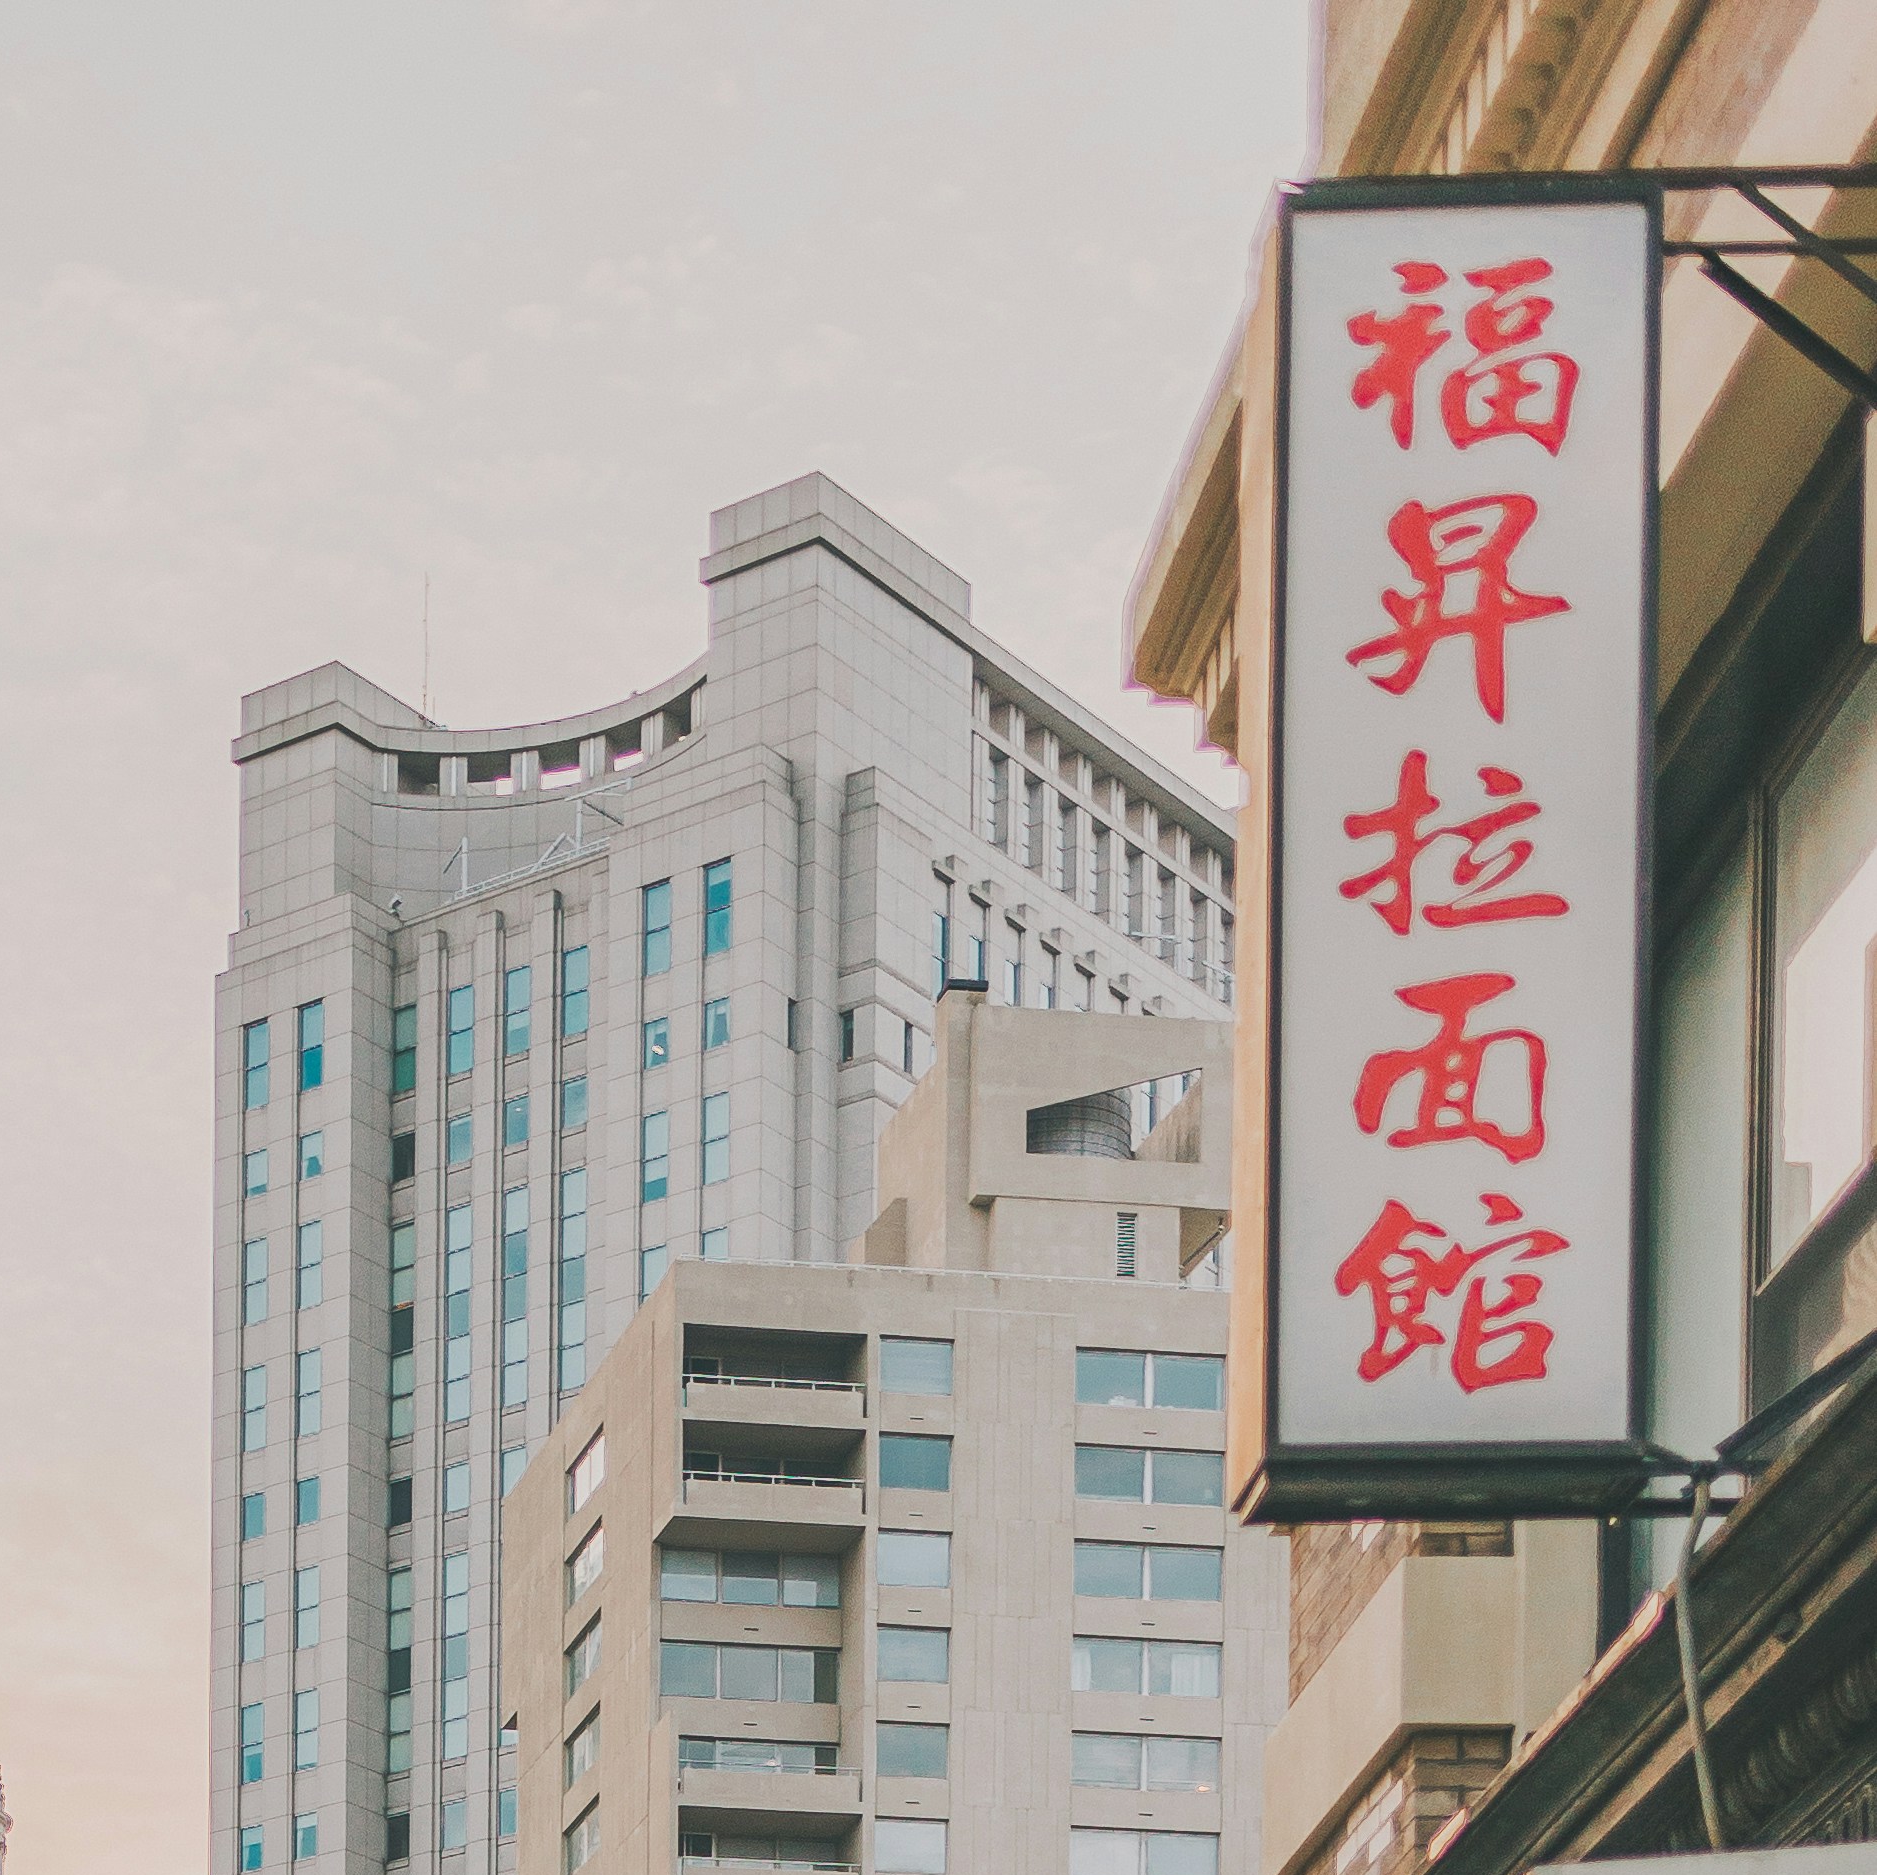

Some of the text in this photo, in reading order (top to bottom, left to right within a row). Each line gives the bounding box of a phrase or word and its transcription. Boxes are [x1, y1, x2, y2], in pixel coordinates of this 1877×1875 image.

[1336, 258, 1579, 1395] 福昇拉面館
